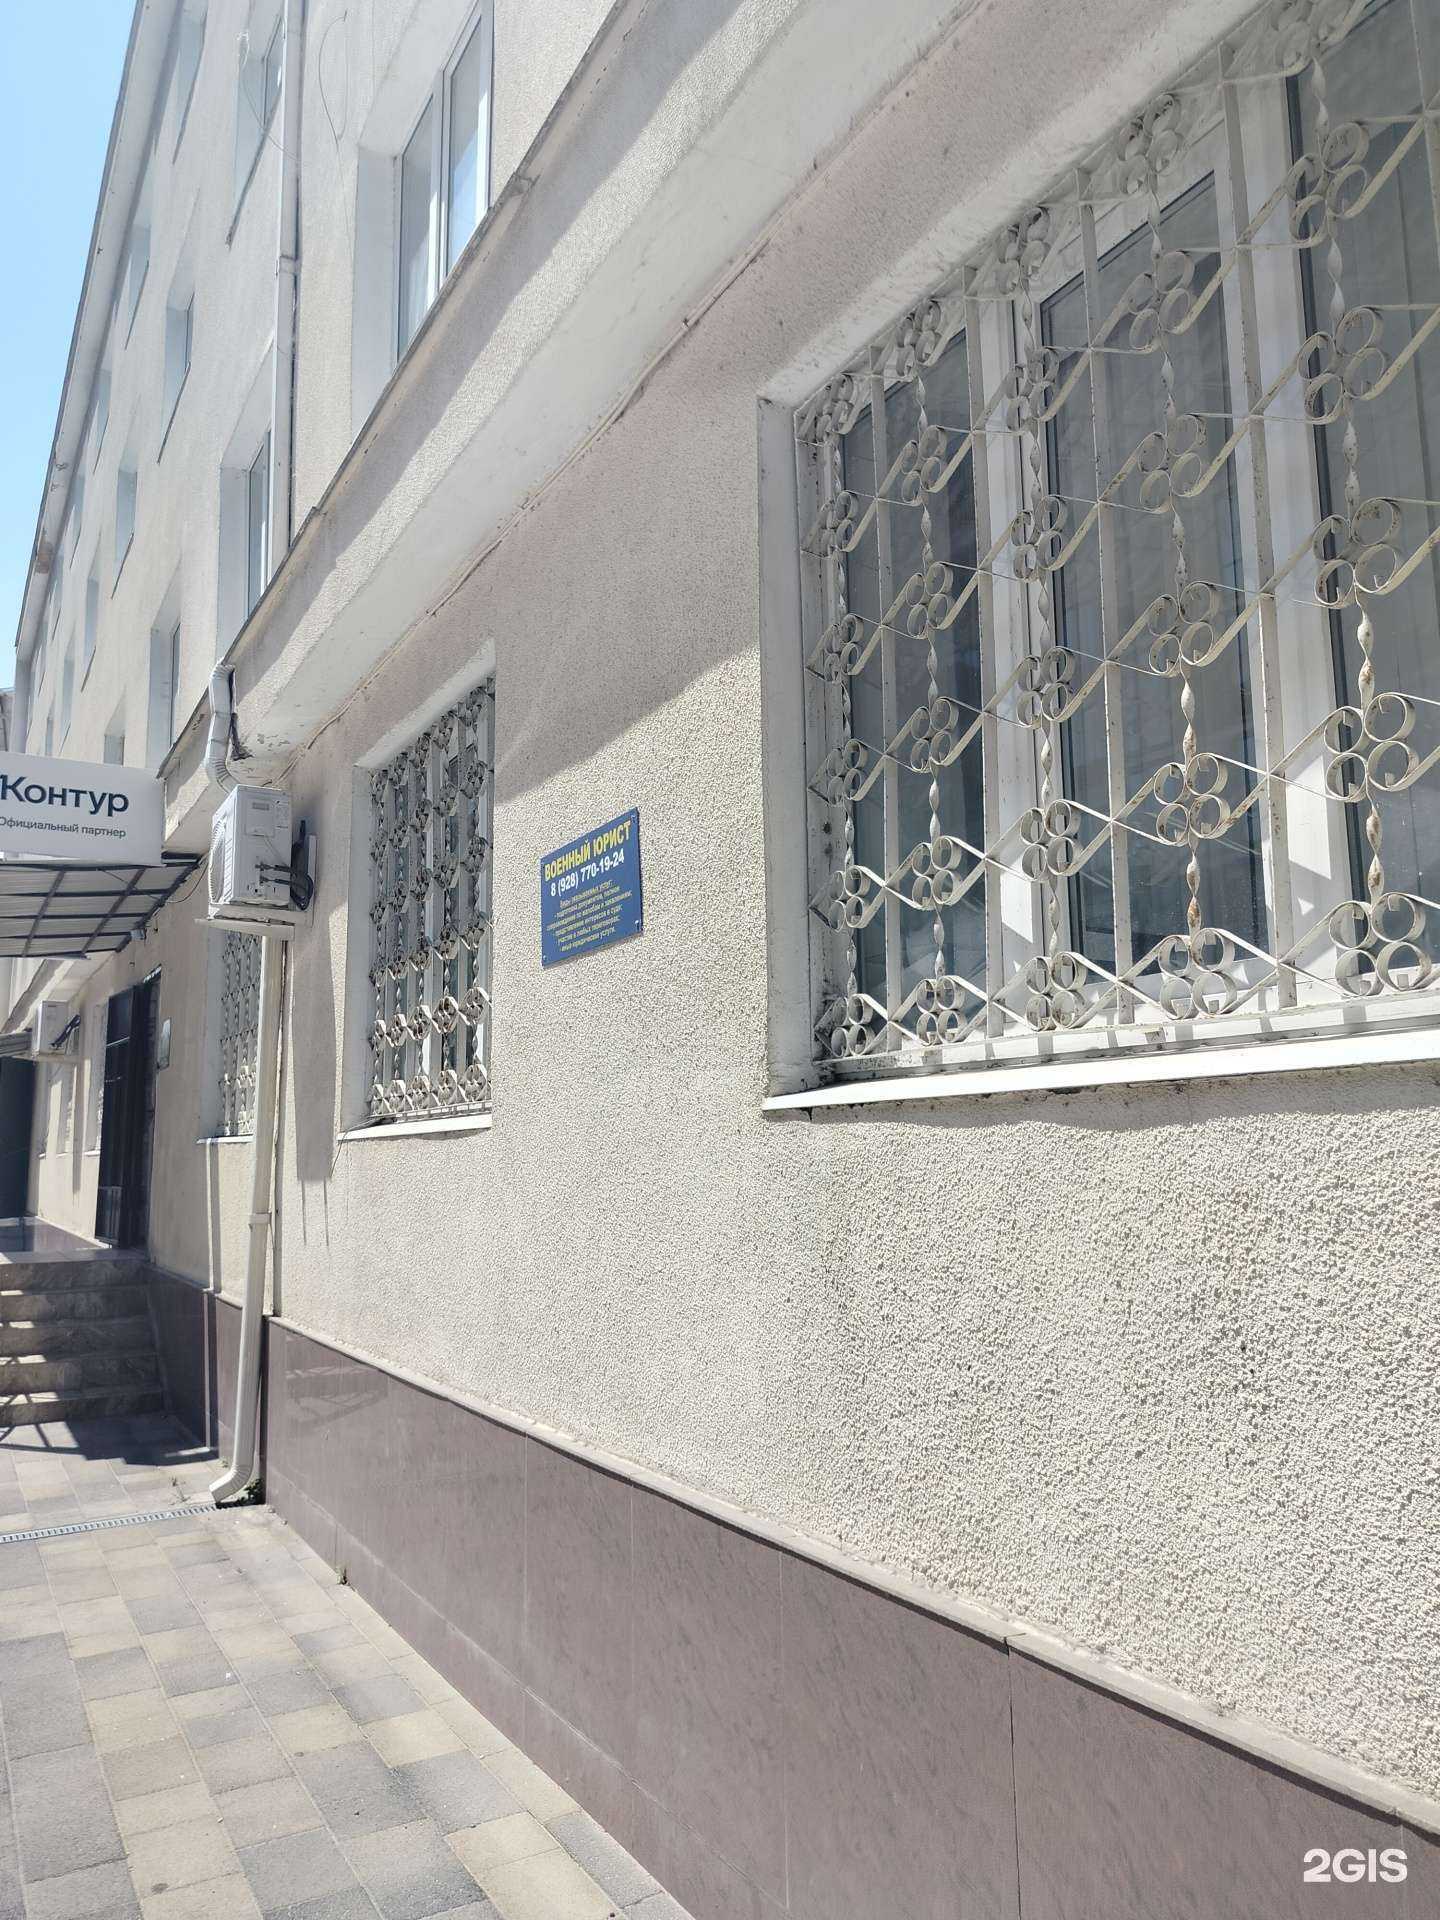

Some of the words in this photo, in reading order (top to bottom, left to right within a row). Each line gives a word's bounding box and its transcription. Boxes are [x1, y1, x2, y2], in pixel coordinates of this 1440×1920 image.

[0, 774, 129, 817] Контур
[0, 816, 79, 833] Официальный
[81, 826, 126, 839] партнер
[544, 840, 591, 882] ВОЕННЫЙ
[593, 820, 632, 857] ЮРИСТ
[550, 882, 556, 897] 8
[558, 872, 579, 897] (928)
[580, 848, 625, 883] 770-19-24
